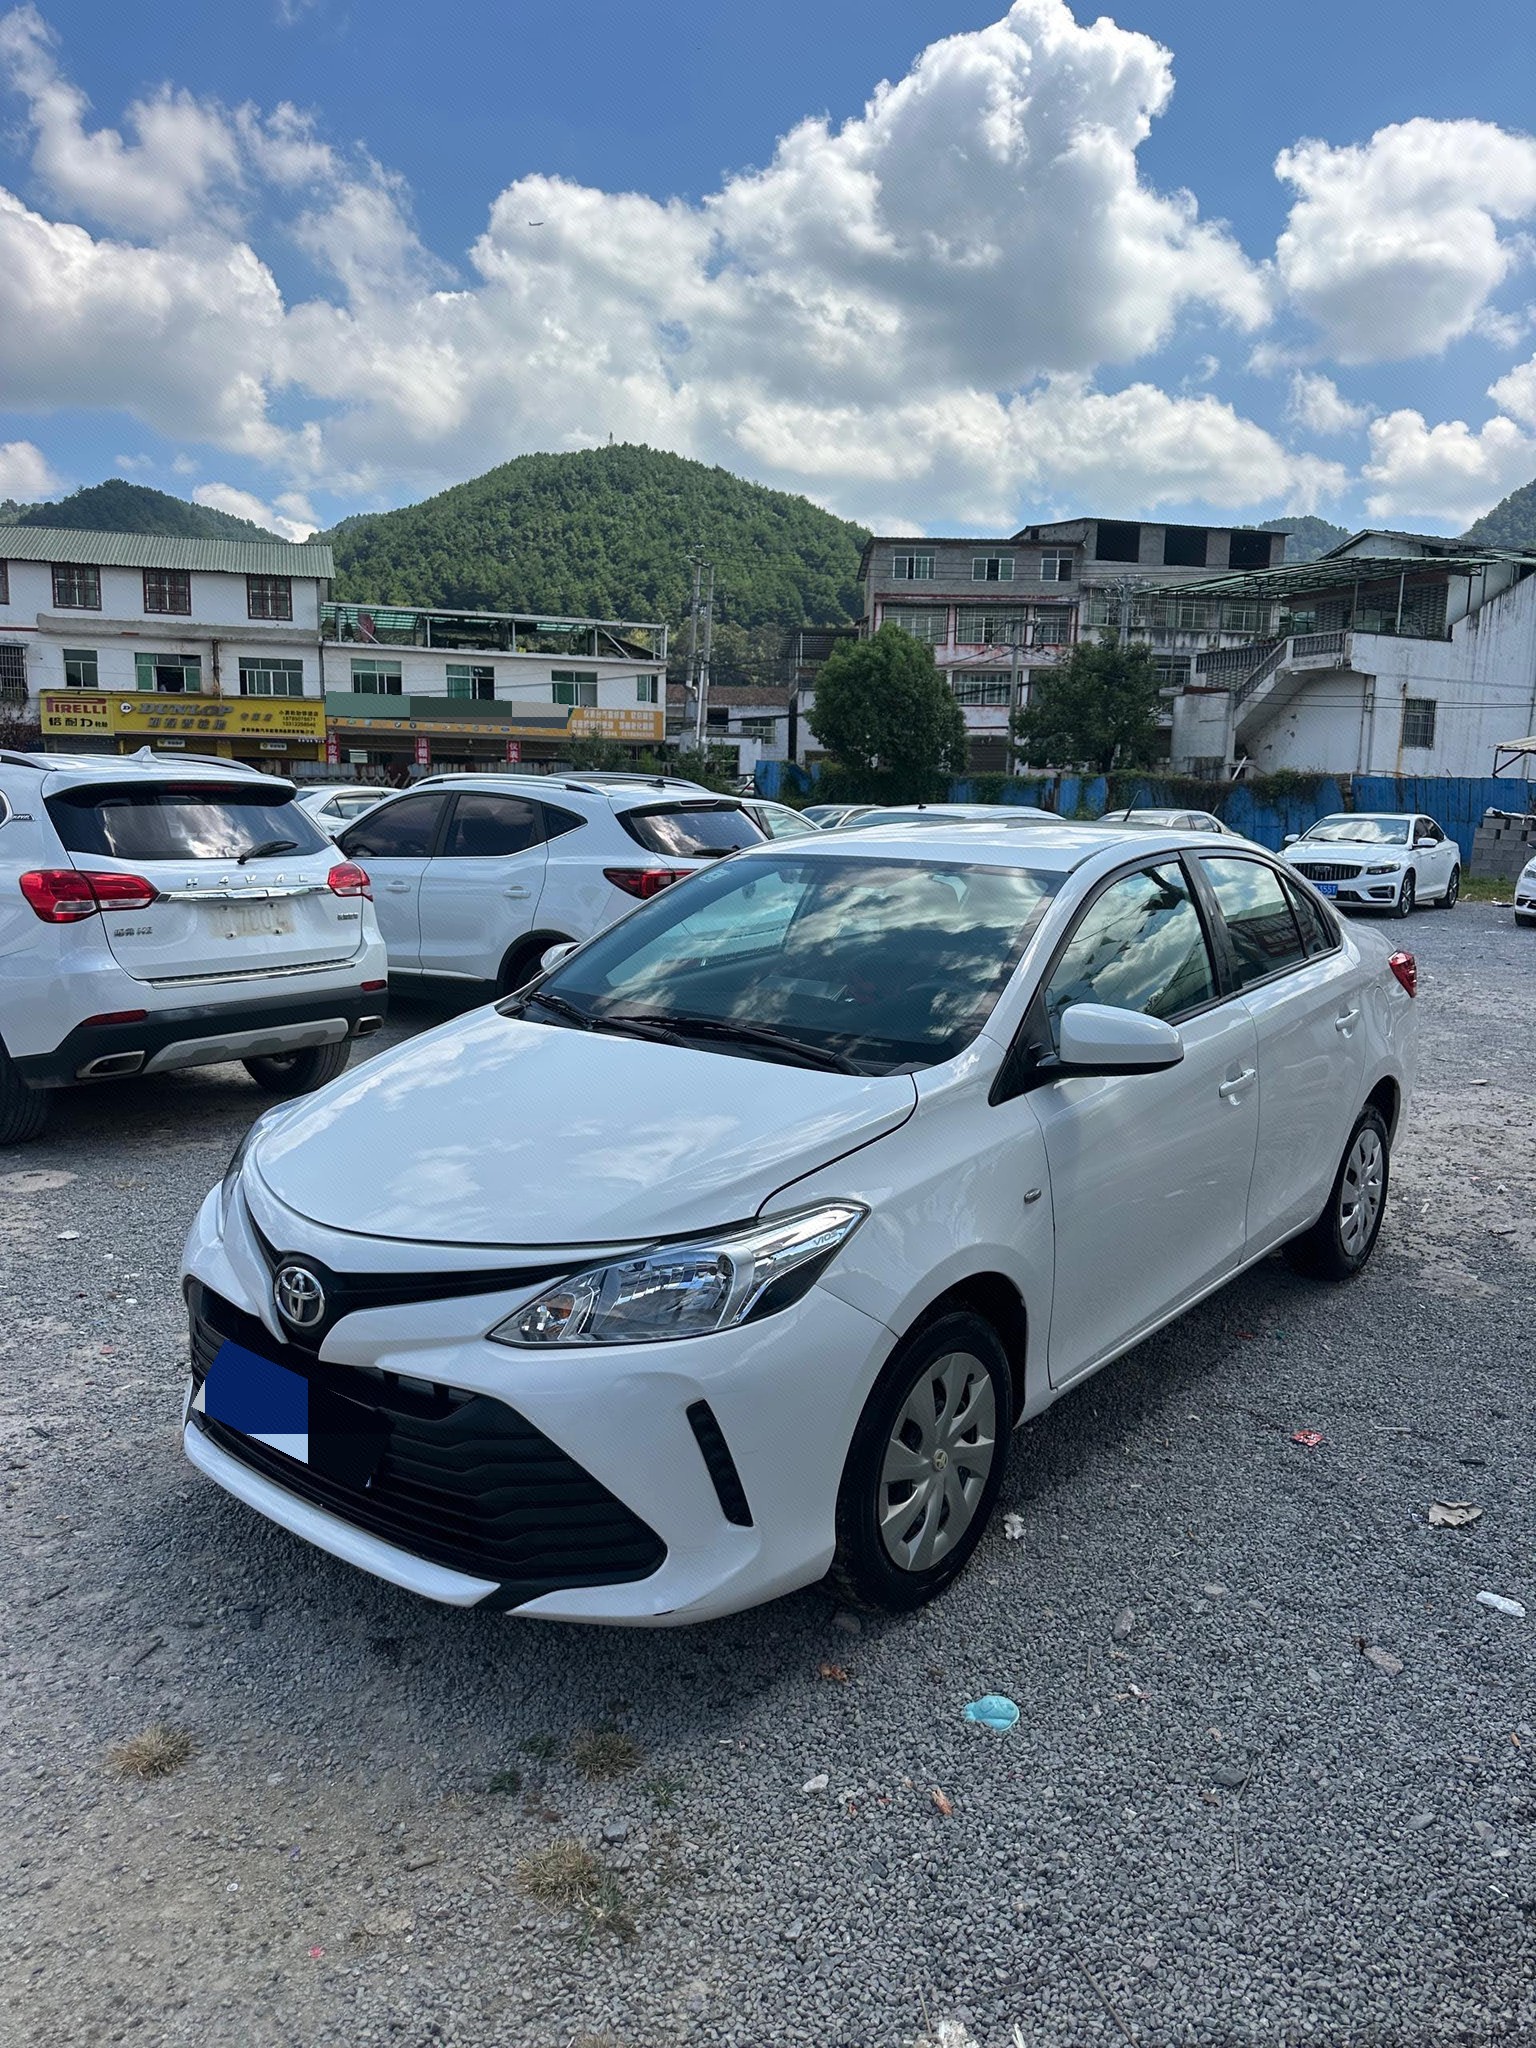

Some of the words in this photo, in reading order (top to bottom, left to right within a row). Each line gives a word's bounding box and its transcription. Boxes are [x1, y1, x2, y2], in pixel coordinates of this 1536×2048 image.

[46, 696, 107, 714] PIRELLI
[138, 703, 233, 717] DUNLOP
[186, 873, 308, 889] HAVAL
[813, 1231, 838, 1246] VIOS
